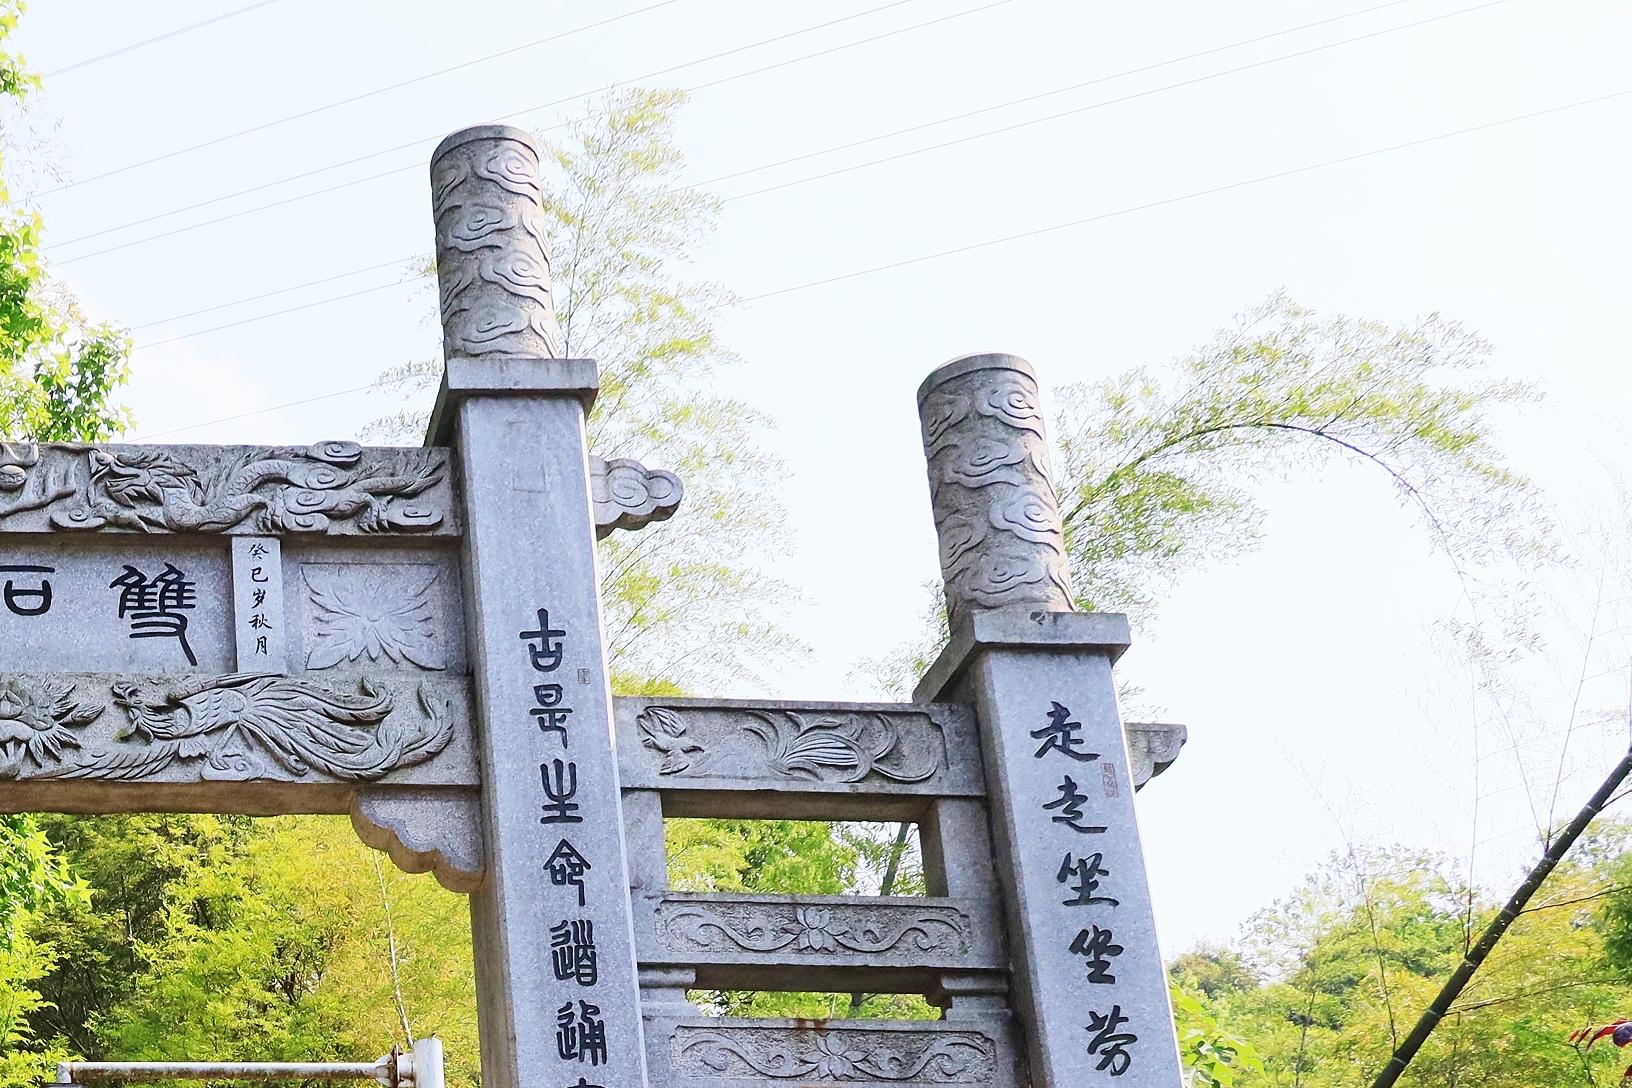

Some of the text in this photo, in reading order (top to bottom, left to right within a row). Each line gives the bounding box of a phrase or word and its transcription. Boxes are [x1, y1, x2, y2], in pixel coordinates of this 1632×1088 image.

[248, 543, 273, 656] 癸巳岁秋月
